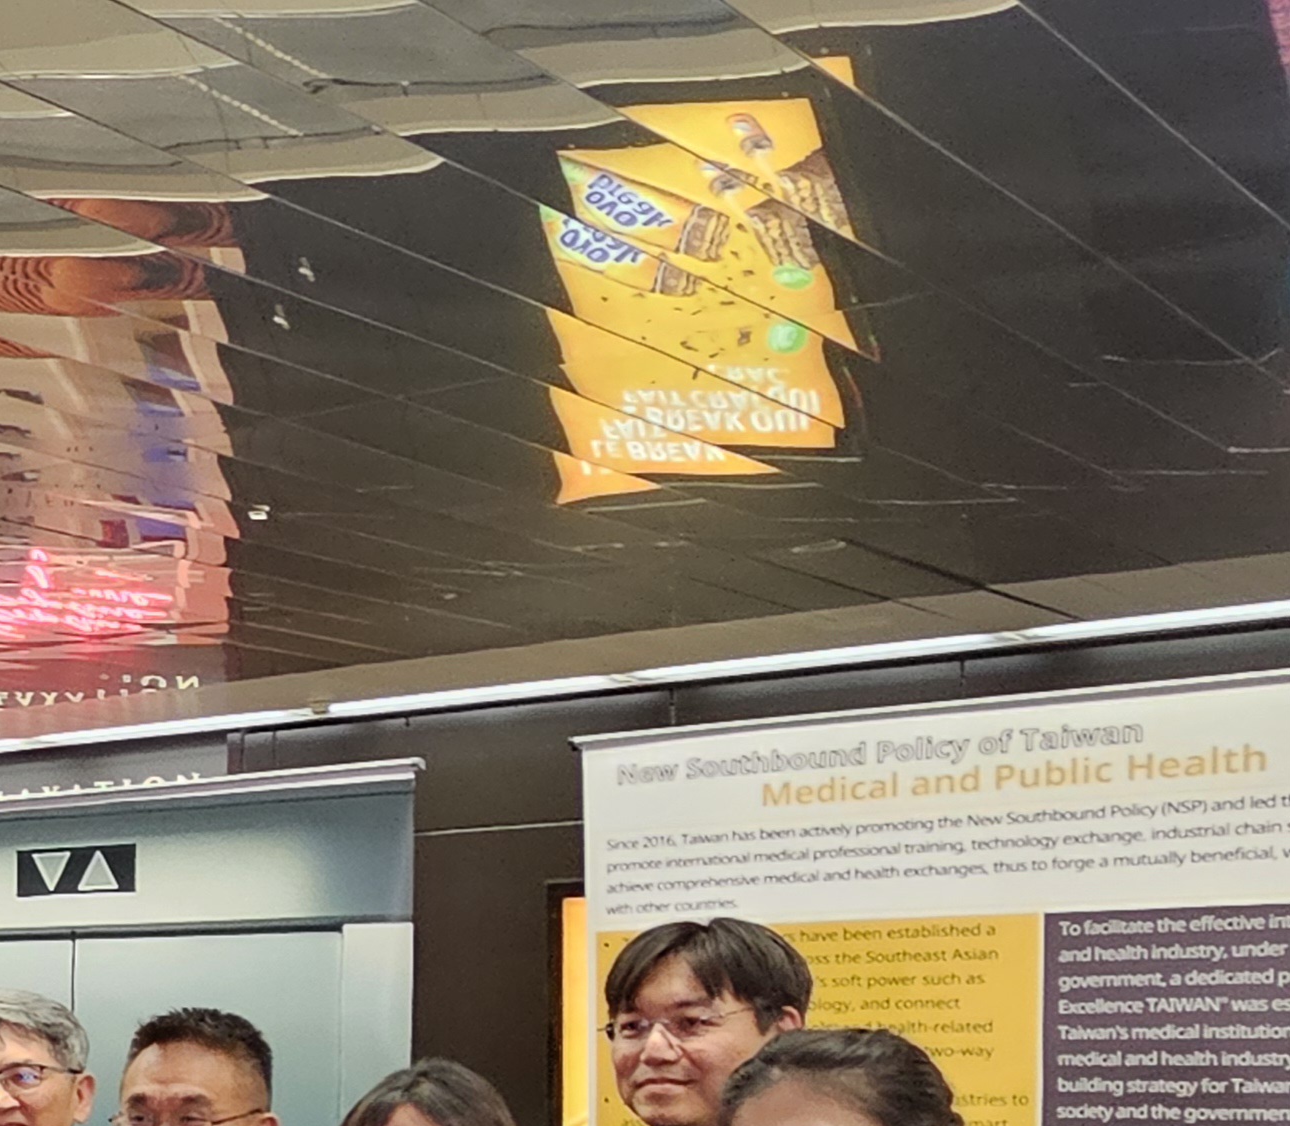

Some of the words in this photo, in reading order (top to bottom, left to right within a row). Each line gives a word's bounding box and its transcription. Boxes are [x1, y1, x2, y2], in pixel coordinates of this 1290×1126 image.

[617, 763, 679, 785] New
[686, 741, 866, 780] Southbound
[877, 736, 971, 764] Policy
[978, 729, 1013, 755] of
[1020, 722, 1143, 751] Taiwan
[762, 772, 898, 807] Medical
[911, 765, 980, 795] and
[995, 756, 1112, 790] Public
[1128, 743, 1267, 780] Health
[682, 832, 729, 844] Taiwan
[732, 831, 756, 841] has
[760, 829, 795, 840] been
[799, 824, 852, 838] actively
[856, 817, 933, 836] promoting
[938, 817, 963, 828] the
[968, 815, 1003, 827] New
[1007, 806, 1105, 824] Southbound
[1111, 804, 1158, 818] Policy
[1162, 800, 1207, 814] (NSP)
[1211, 798, 1244, 811] and
[1250, 795, 1275, 808] led
[972, 835, 1058, 850] technology
[1151, 824, 1230, 840] industrial
[1235, 820, 1281, 835] chain
[993, 861, 1027, 873] thus
[1032, 860, 1047, 871] to
[1052, 856, 1094, 873] forge
[1114, 852, 1186, 867] mutually
[800, 929, 838, 942] have
[844, 927, 882, 941] been
[887, 924, 981, 939] established
[986, 926, 995, 936] a
[1059, 921, 1081, 936] To
[1085, 919, 1154, 934] facilitate
[1157, 918, 1186, 932] the
[1190, 915, 1265, 932] effective
[835, 951, 862, 964] the
[866, 949, 946, 964] Southeast
[952, 949, 998, 961] Asian
[1059, 947, 1091, 962] and
[1095, 945, 1148, 960] health
[1151, 944, 1228, 961] industry,
[1232, 941, 1288, 958] under
[832, 976, 862, 988] soft
[867, 975, 917, 989] power
[922, 973, 961, 986] such
[966, 974, 985, 985] as
[1170, 974, 1181, 986] a
[1185, 969, 1274, 985] dedicated
[860, 997, 890, 1010] and
[895, 997, 960, 1010] connect
[1058, 999, 1144, 1014] Excellence
[1231, 999, 1268, 1012] was
[1058, 1025, 1128, 1040] Taiwan's
[1132, 1024, 1199, 1039] medical
